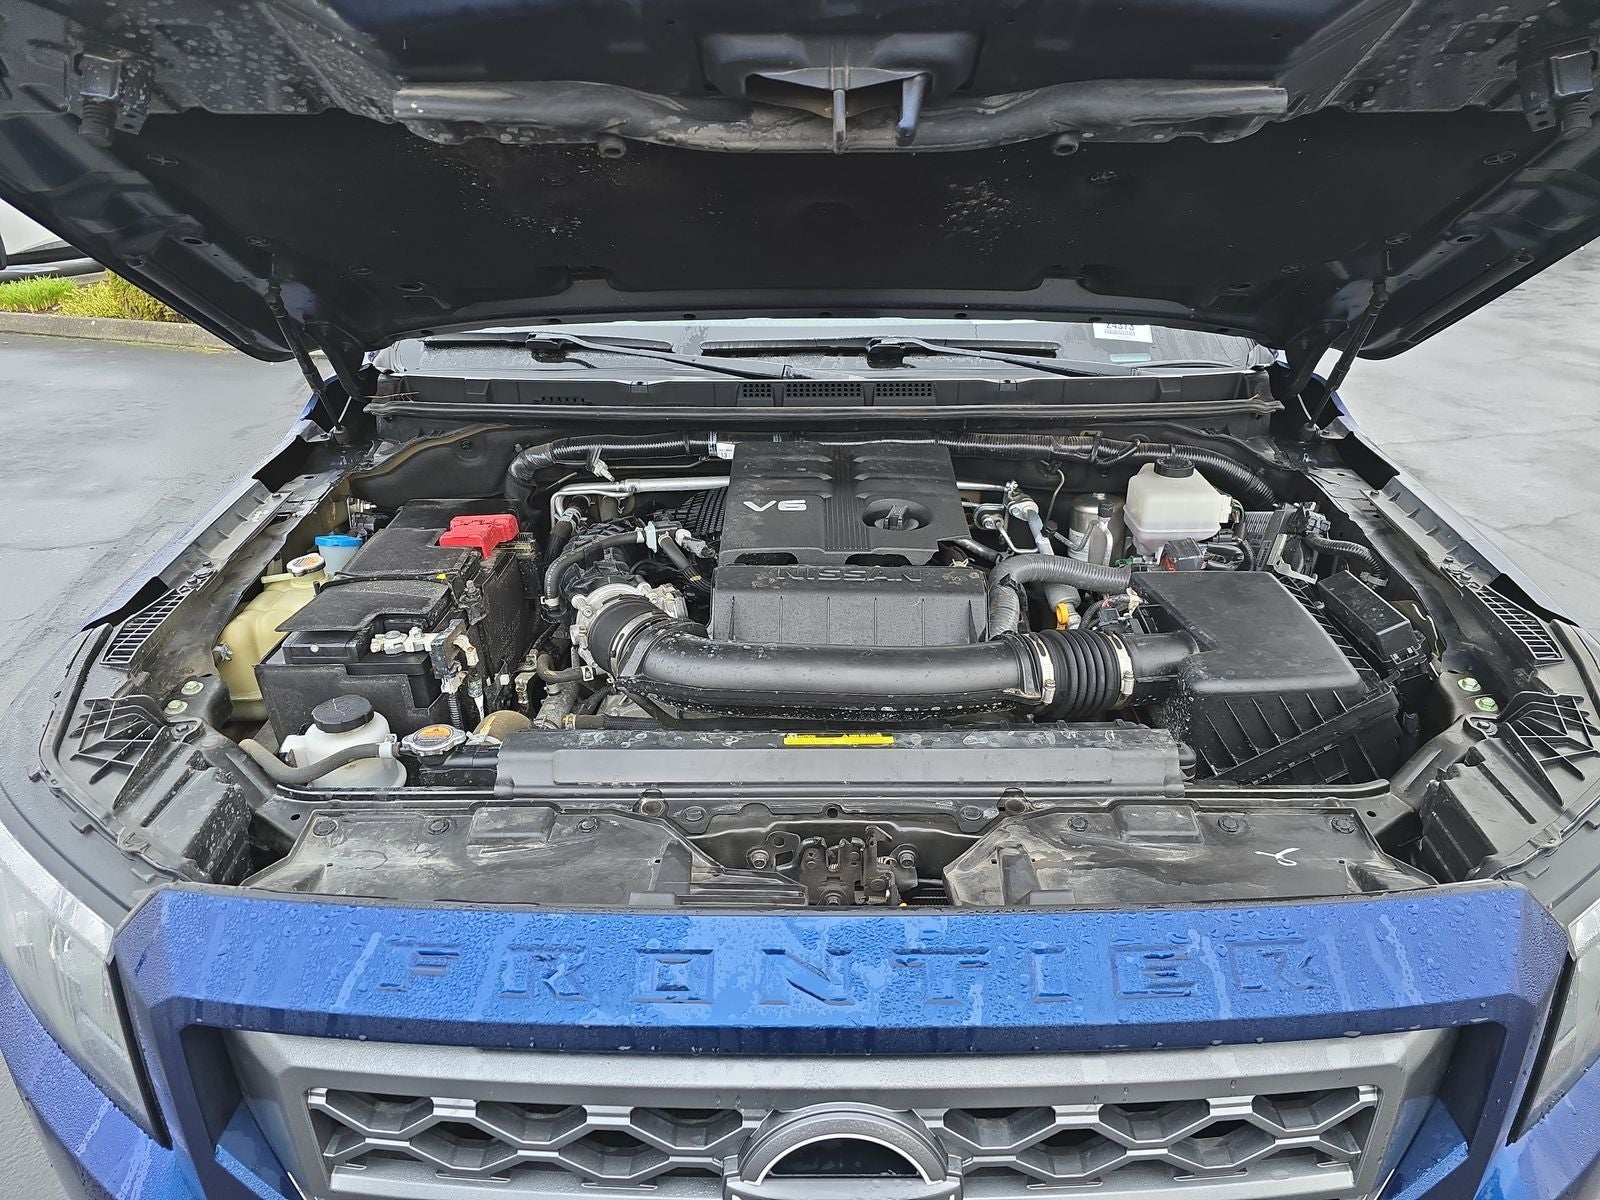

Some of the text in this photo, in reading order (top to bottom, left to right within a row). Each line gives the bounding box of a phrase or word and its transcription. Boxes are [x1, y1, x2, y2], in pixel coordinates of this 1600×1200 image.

[743, 499, 807, 512] V6
[776, 567, 922, 582] NISSAN
[374, 938, 1326, 1005] FRONTIER
